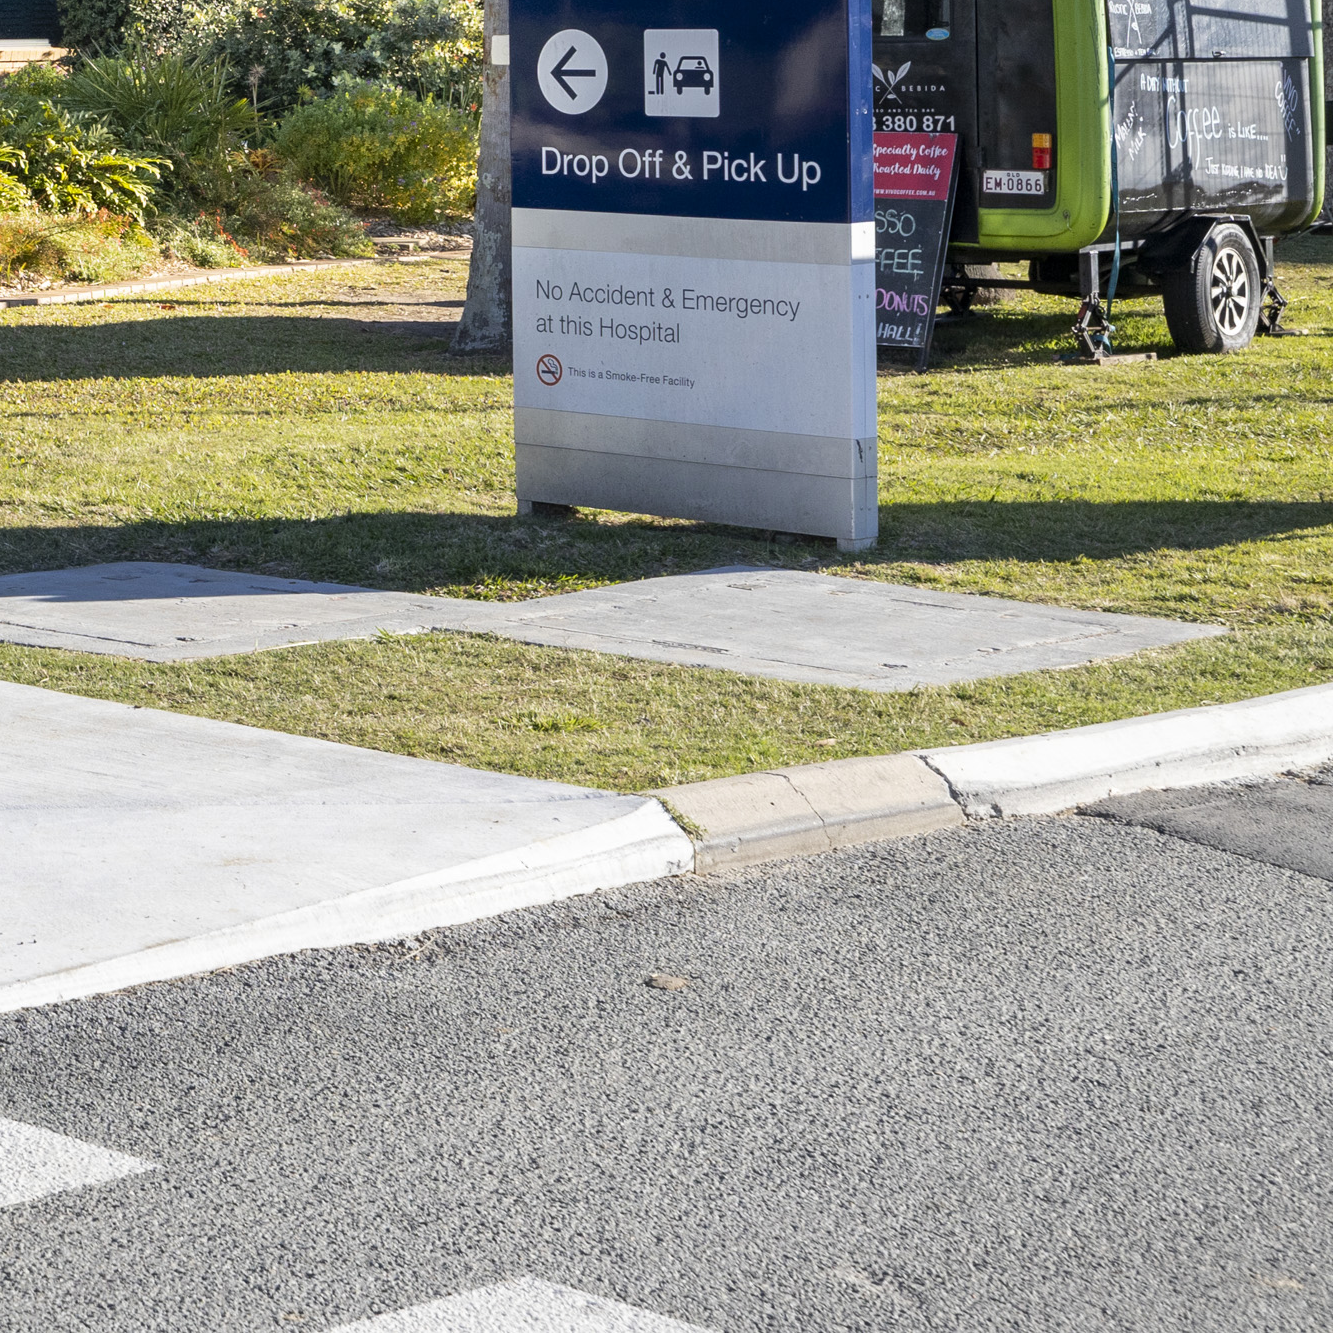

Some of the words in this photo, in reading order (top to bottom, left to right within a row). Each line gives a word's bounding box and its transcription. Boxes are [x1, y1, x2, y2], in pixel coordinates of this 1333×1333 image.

[882, 115, 917, 131] 380
[923, 115, 955, 131] 871
[873, 143, 917, 160] Specialty
[919, 145, 948, 158] Coffee
[541, 146, 609, 183] Drop
[618, 148, 663, 178] Off
[672, 150, 693, 180] &
[703, 151, 767, 182] Pick
[777, 153, 821, 191] Up
[873, 163, 912, 175] Roasted
[913, 163, 941, 180] Daily
[536, 279, 563, 301] No
[569, 281, 655, 307] Accident
[662, 287, 675, 309] &
[683, 289, 800, 321] Emergency
[875, 288, 929, 316] DONUTS
[536, 316, 553, 334] at
[559, 315, 593, 337] this
[600, 318, 680, 345] Hospital
[568, 366, 586, 379] This
[588, 368, 596, 379] is
[598, 371, 603, 379] a
[606, 370, 660, 385] Smoke-Free
[662, 375, 695, 389] Facility
